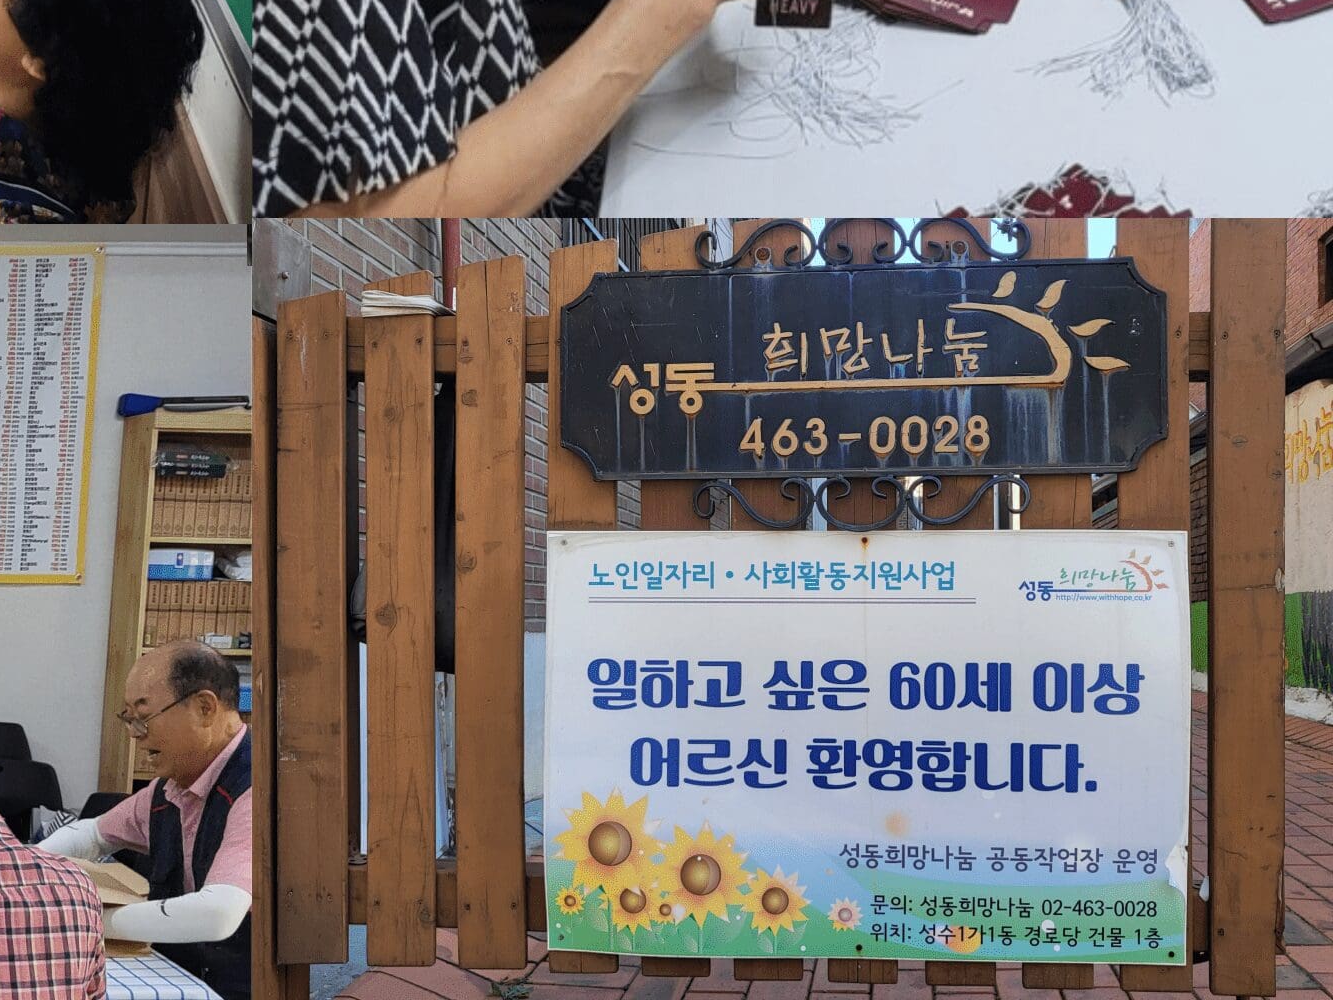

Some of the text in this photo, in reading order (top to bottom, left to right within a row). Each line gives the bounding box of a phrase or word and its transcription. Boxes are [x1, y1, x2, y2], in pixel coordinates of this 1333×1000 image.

[769, 0, 819, 16] HEAVY
[761, 318, 989, 377] 희망나눔
[609, 360, 715, 416] 성동
[739, 415, 992, 458] 463-0028
[587, 560, 957, 593] 노인일자리 사회활동지원사업
[1018, 567, 1137, 602] 성동 희망나눔
[1055, 593, 1152, 602] http://www.withhope.co.kr
[586, 657, 1145, 716] 일하고 싶은 60세 이상
[630, 737, 1098, 793] 어르신 환영합니다.
[839, 843, 1158, 875] 성동희망나눔 공동작업장 운영
[870, 895, 1158, 918] 문의: 성동희망나눔 02-463-0028
[870, 923, 1163, 949] 위치: 성수1가1동 경로당 건물 1층
